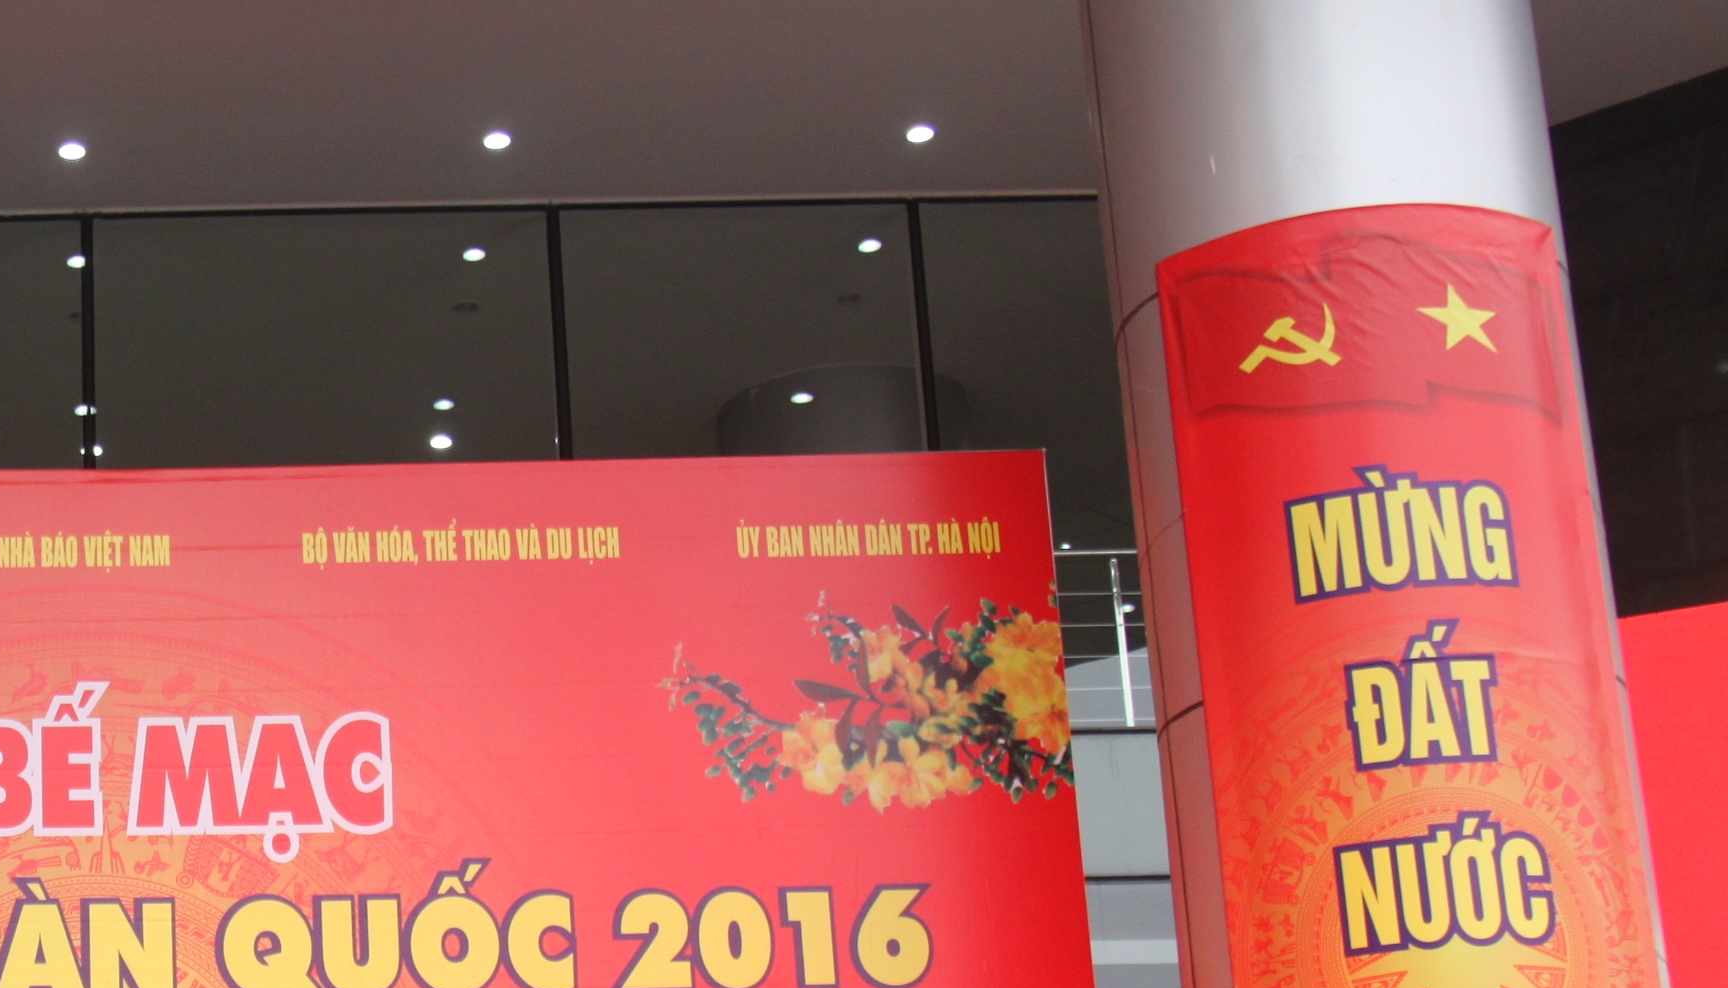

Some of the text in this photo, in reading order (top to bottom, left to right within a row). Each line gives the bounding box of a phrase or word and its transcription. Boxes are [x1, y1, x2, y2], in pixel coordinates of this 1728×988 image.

[40, 531, 79, 568] BÁO
[83, 530, 124, 573] VIỆT
[128, 534, 171, 567] NAM
[302, 518, 621, 570] BỘ VĂN HÓA, THỂ THAO VÀ DU LỊCH
[735, 516, 1002, 560] ỦY BAN NHÂN DÂN TP. HÀ NỘI
[1284, 464, 1519, 605] MỪNG
[1344, 618, 1498, 772] ĐẤT
[126, 712, 394, 864] MẠC
[1333, 811, 1556, 958] NƯỚC
